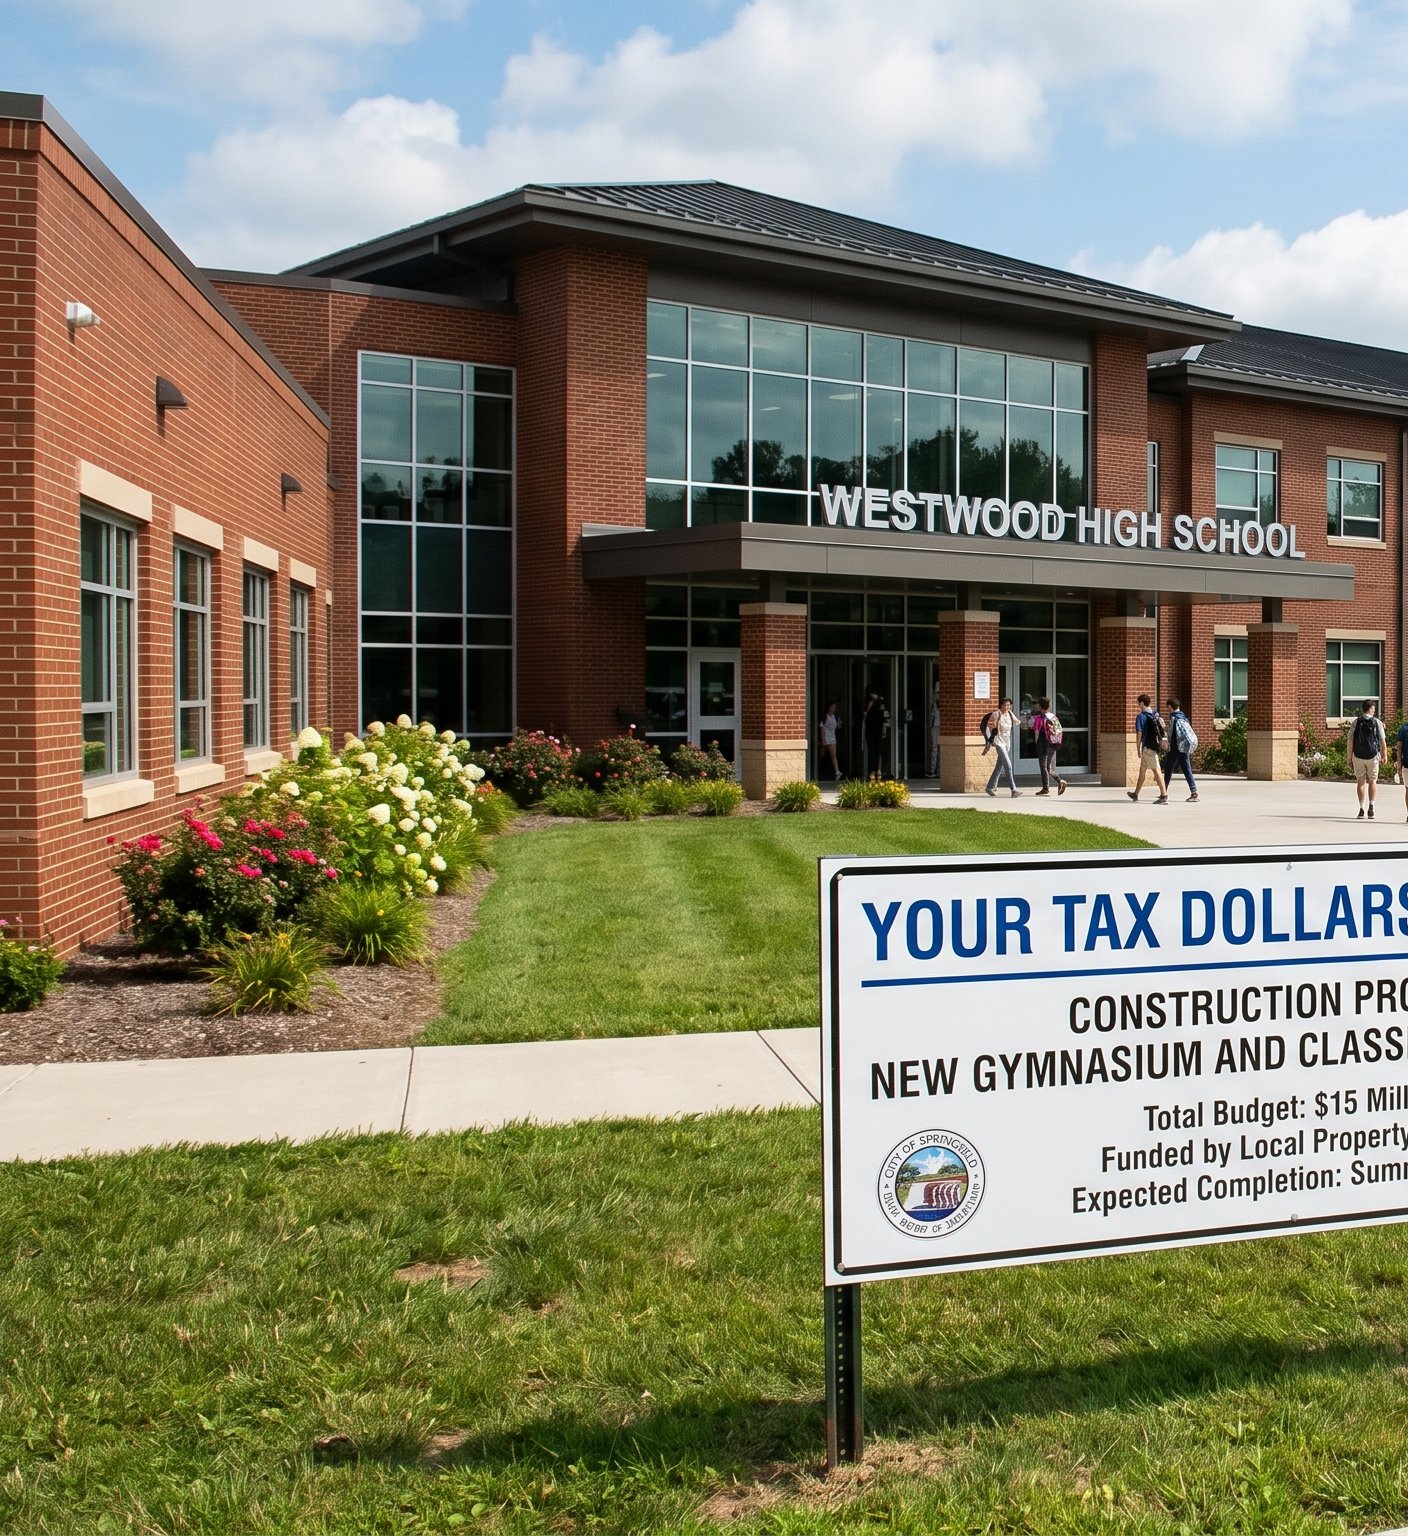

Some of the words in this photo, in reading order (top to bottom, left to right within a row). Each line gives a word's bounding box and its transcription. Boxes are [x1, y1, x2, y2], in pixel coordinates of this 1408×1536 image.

[818, 484, 1065, 541] WESTWOOD
[1076, 506, 1162, 549] HIGH
[1172, 514, 1306, 558] SCHOOL
[862, 898, 1032, 961] YOUR
[1053, 892, 1161, 952] TAX
[1069, 981, 1341, 1034] CONSTRUCTION
[871, 1058, 958, 1100] NEW
[973, 1041, 1202, 1093] GYMNASIUM
[1215, 1036, 1286, 1074] AND
[1143, 1102, 1203, 1132] Total
[1213, 1095, 1306, 1128] Budget:
[1315, 1089, 1358, 1121] $15
[902, 1140, 917, 1154] OF
[1102, 1140, 1194, 1173] Funded
[1203, 1138, 1232, 1169] by
[1240, 1130, 1304, 1161] Local
[1072, 1178, 1187, 1217] Expected
[1197, 1167, 1342, 1205] Completion:
